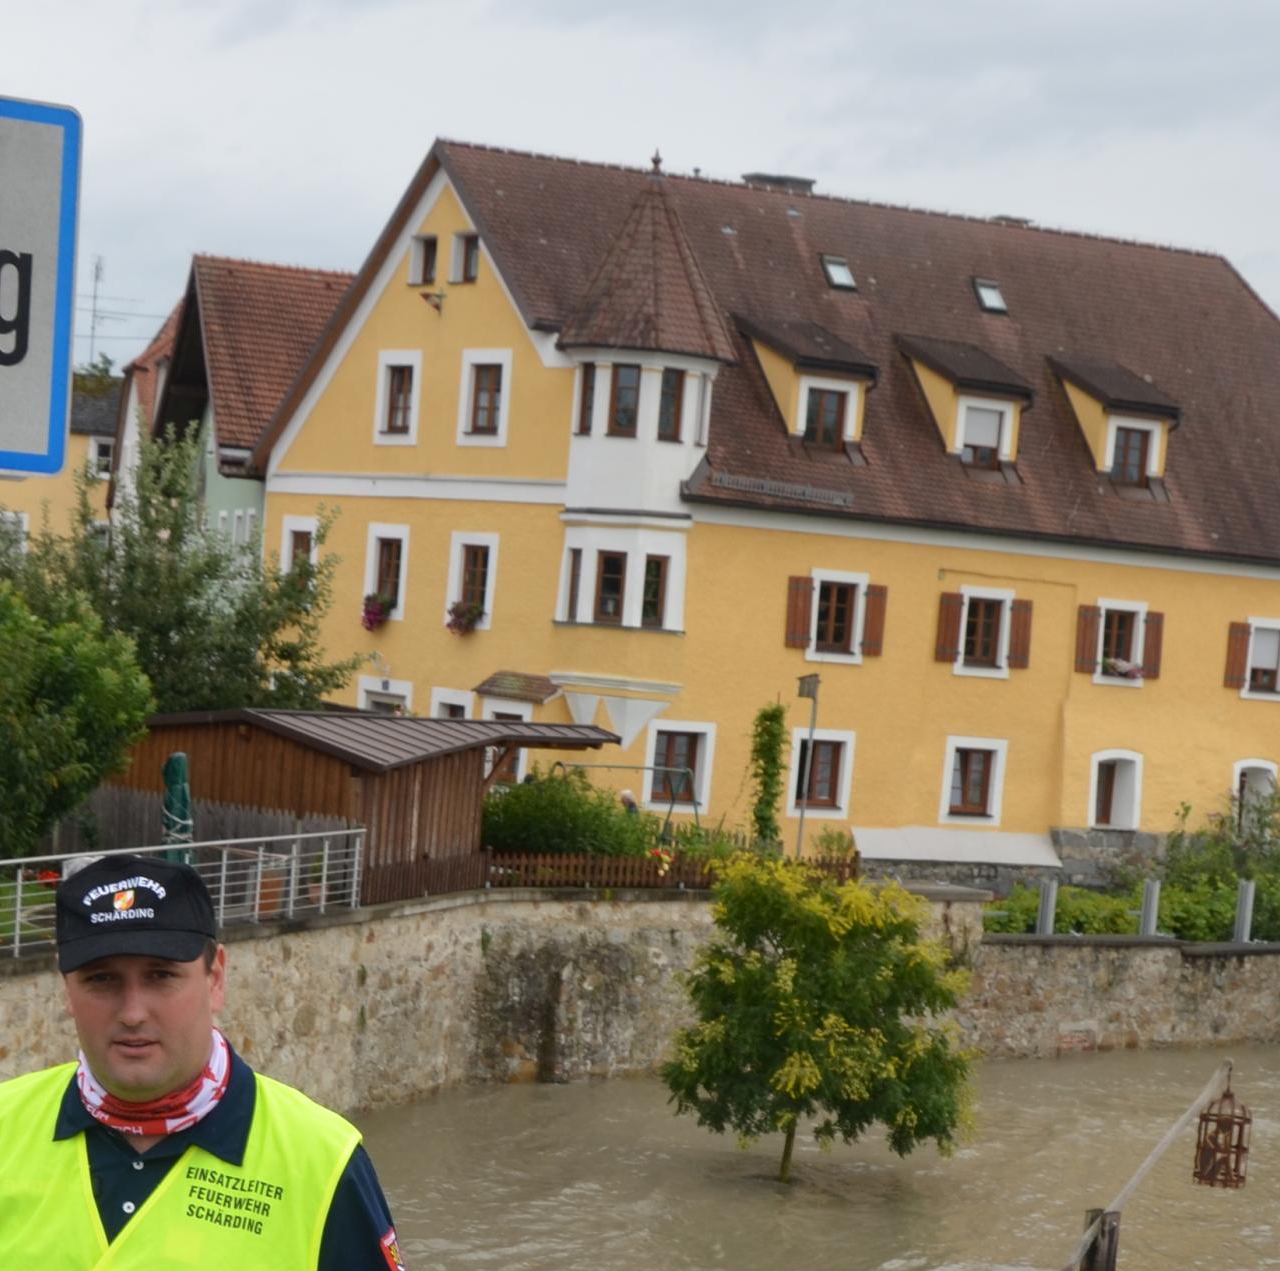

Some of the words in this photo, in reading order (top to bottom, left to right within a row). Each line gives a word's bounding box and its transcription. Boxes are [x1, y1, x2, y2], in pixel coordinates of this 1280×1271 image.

[83, 876, 167, 907] FEUERWEHR
[186, 1166, 284, 1201] EINSATZLEITER
[188, 1185, 271, 1217] FEUERWEHR
[186, 1203, 263, 1235] SCHÄRDING
